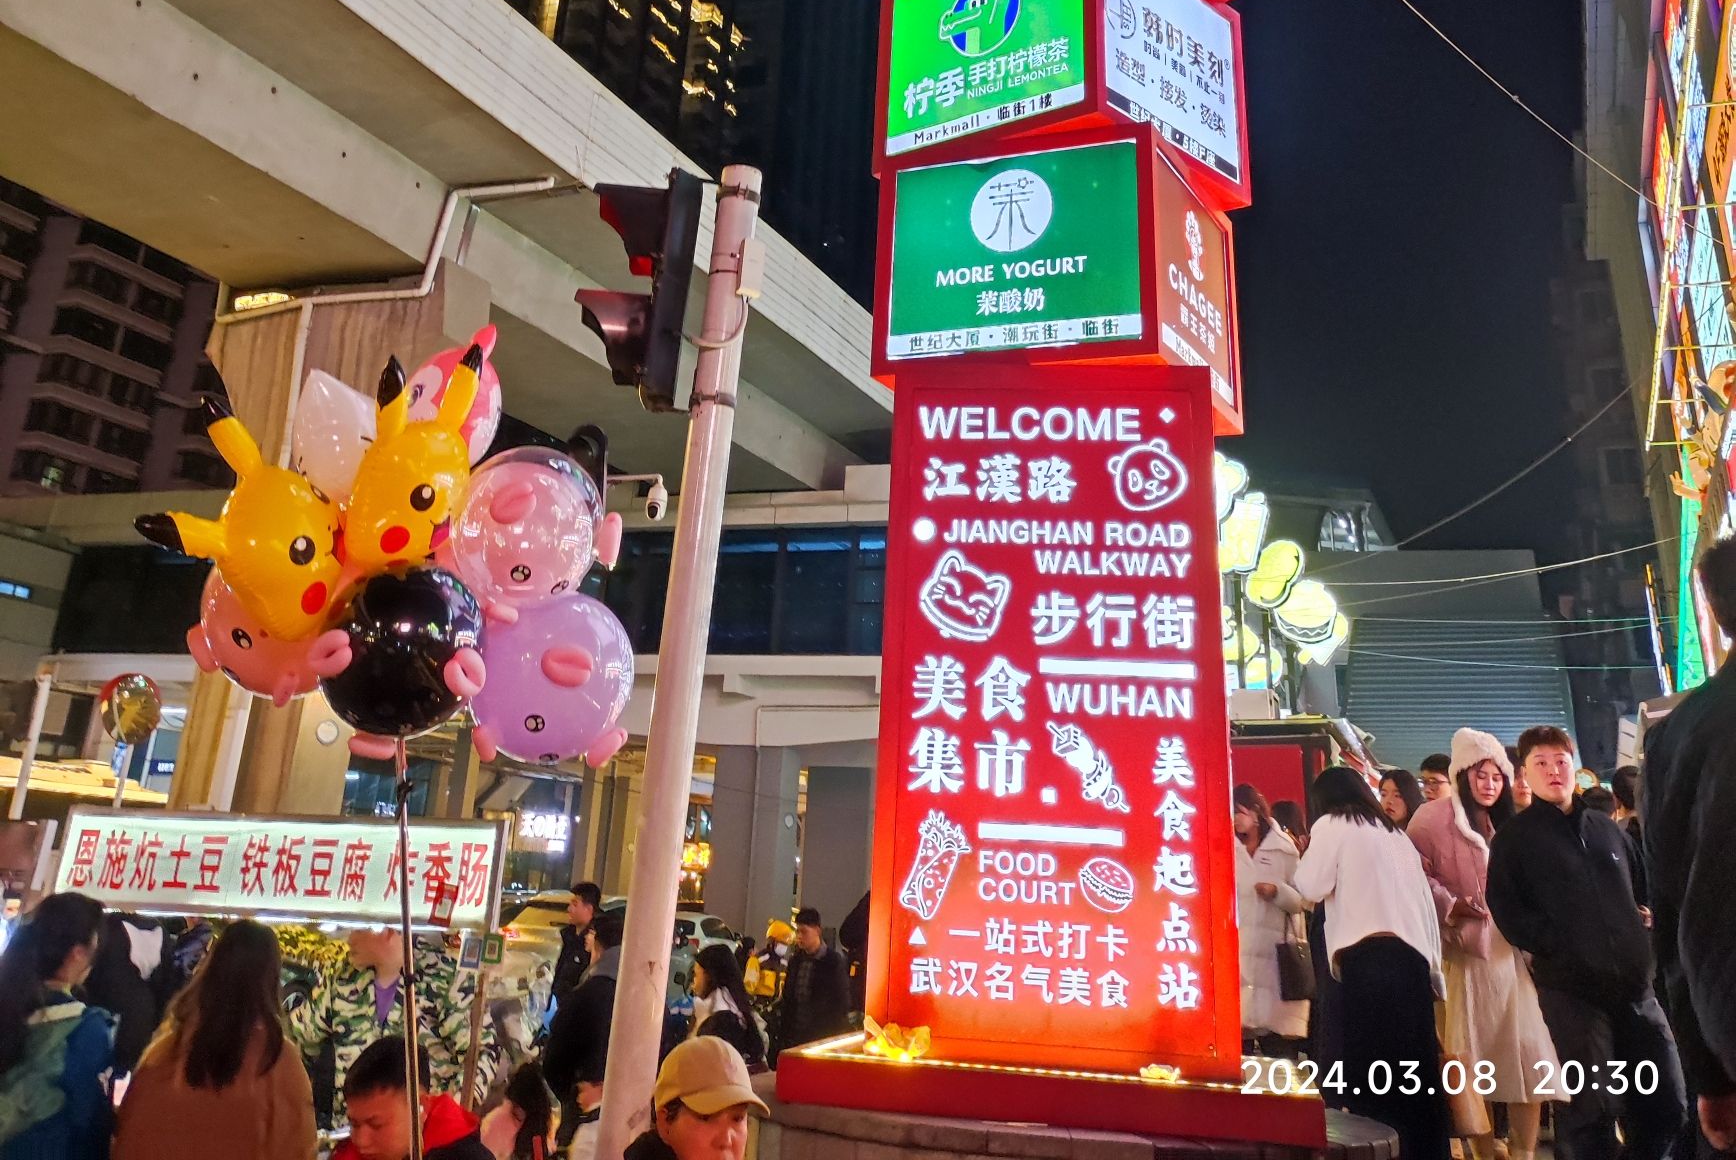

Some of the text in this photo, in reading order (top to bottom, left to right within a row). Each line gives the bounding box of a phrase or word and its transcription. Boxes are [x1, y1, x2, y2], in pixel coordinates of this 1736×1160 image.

[967, 37, 1070, 85] 手打柠檬茶
[967, 63, 1069, 100] NINGJI LEMONTEA
[903, 66, 965, 119] 柠季
[935, 255, 1088, 288] MORE YOGURT
[976, 287, 1046, 316] 茉酸奶
[1168, 262, 1223, 337] CHAGEE
[918, 406, 1141, 441] WELCOME
[922, 453, 1077, 504] 江漢路
[944, 519, 1191, 548] JIANGHAN ROAD
[1034, 550, 1192, 578] WALKWAY
[1030, 591, 1195, 649] 步行街
[911, 655, 1032, 721] 美食
[1046, 682, 1192, 719] WUHAN
[66, 828, 489, 909] 恩施炕土豆 铁板豆腐 炸香肠
[978, 850, 1056, 877] FOOD
[1152, 736, 1200, 1010] 美食起点站
[978, 877, 1076, 906] COURT
[948, 917, 1130, 962] 一站式打卡
[909, 957, 1131, 1009] 武汉名气美食
